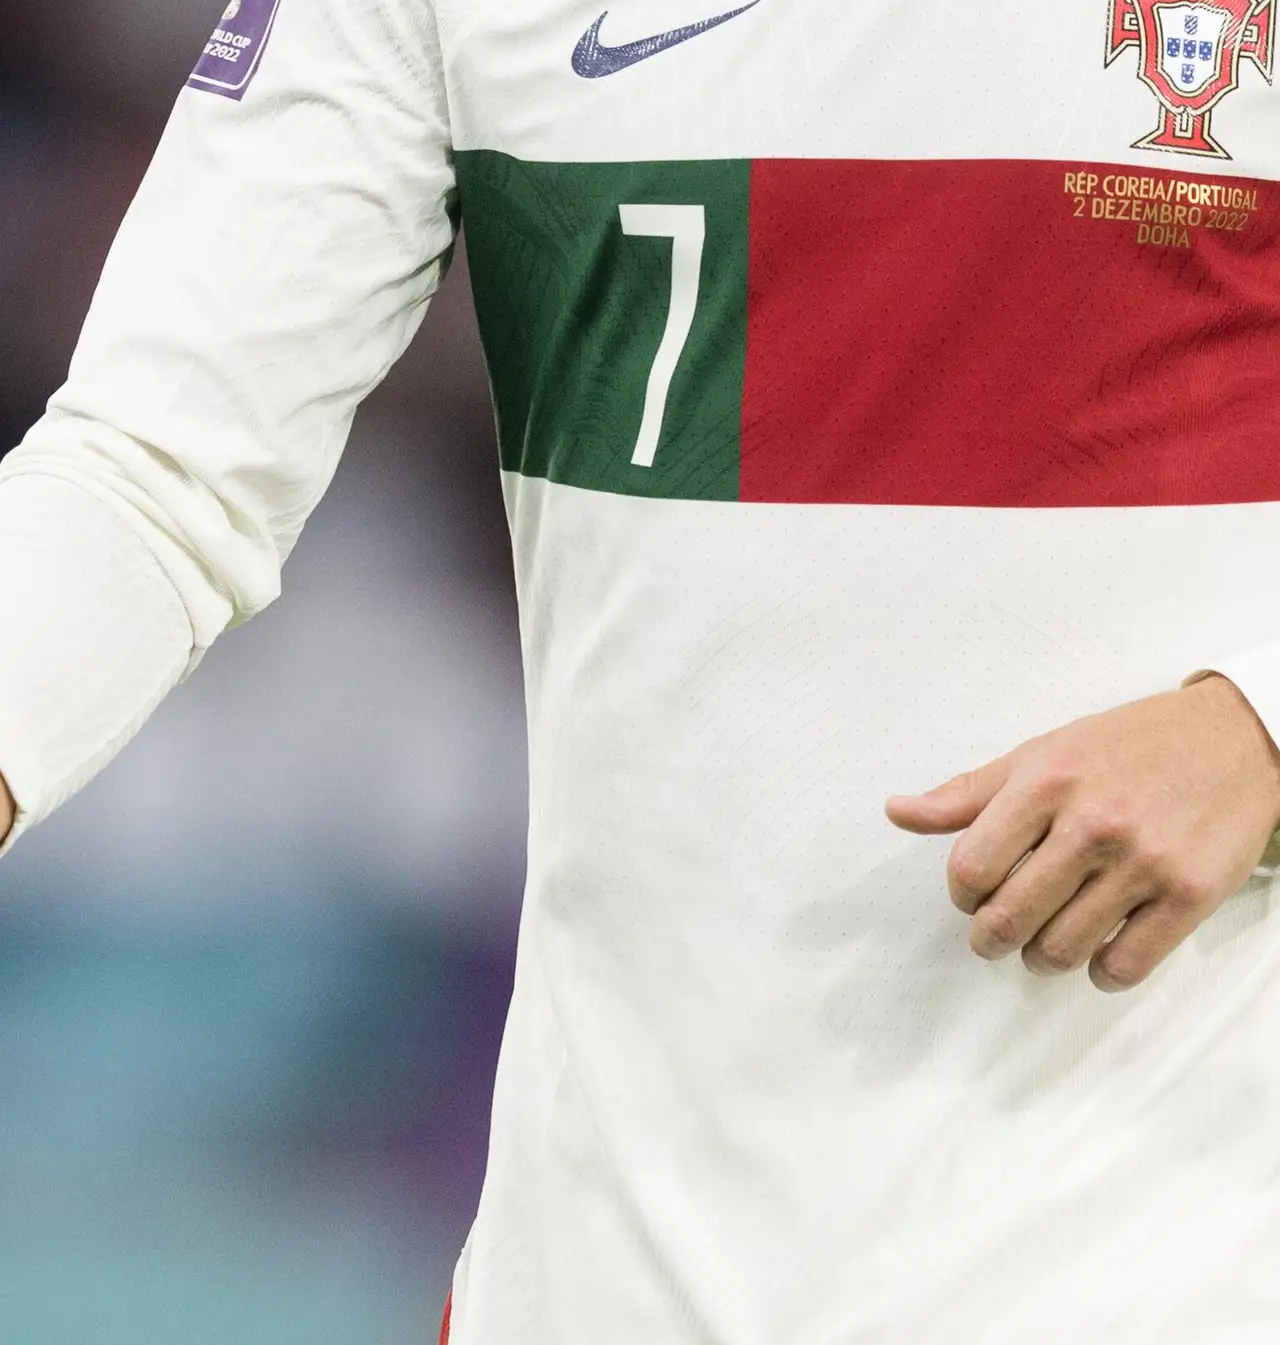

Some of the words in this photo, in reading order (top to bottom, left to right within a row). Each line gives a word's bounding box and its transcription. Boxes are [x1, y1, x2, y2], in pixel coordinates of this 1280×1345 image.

[231, 34, 252, 49] CUP
[1064, 171, 1098, 196] RÉP.
[1103, 175, 1258, 211] COREIA/PORTUGAL
[1073, 196, 1085, 218] 2
[1091, 197, 1202, 227] DEZEMBRO
[1205, 209, 1249, 231] 2022
[1137, 223, 1190, 248] DOHA
[618, 203, 706, 468] 7
